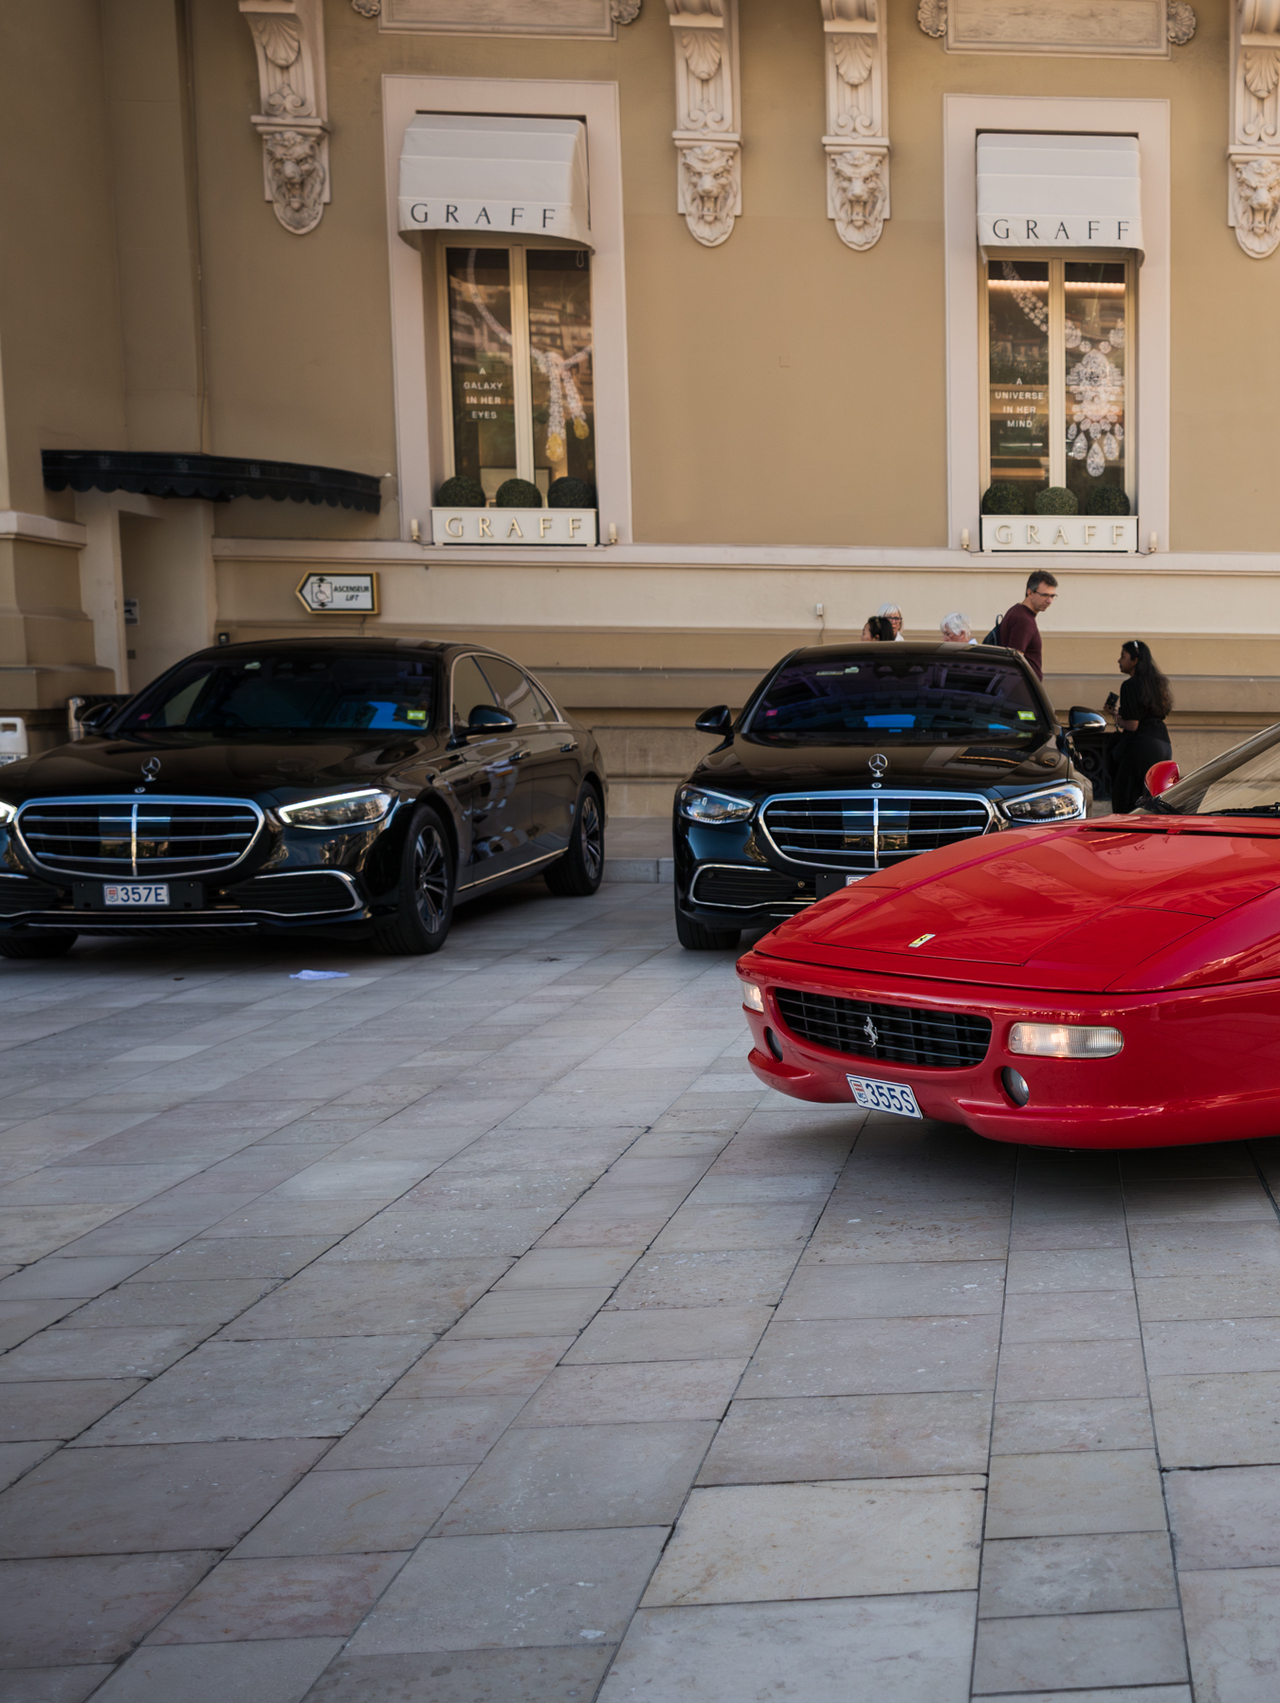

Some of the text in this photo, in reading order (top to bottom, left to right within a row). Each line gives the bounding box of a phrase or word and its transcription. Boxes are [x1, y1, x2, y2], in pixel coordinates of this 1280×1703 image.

[410, 203, 556, 228] GRAFF
[992, 218, 1130, 240] GRAFF
[479, 367, 486, 375] A
[463, 381, 503, 390] GALAXY
[995, 391, 1044, 400] UNIVERSE
[466, 396, 501, 405] IN HER
[1002, 405, 1036, 414] IN HER
[472, 410, 497, 419] EYES
[1007, 420, 1032, 428] MIND
[445, 516, 582, 538] GRAFF
[995, 524, 1125, 545] GRAFF
[333, 585, 370, 593] ASCENSEUR
[345, 594, 360, 602] LIFT
[120, 886, 165, 902] 357E
[865, 1083, 916, 1113] 355S
